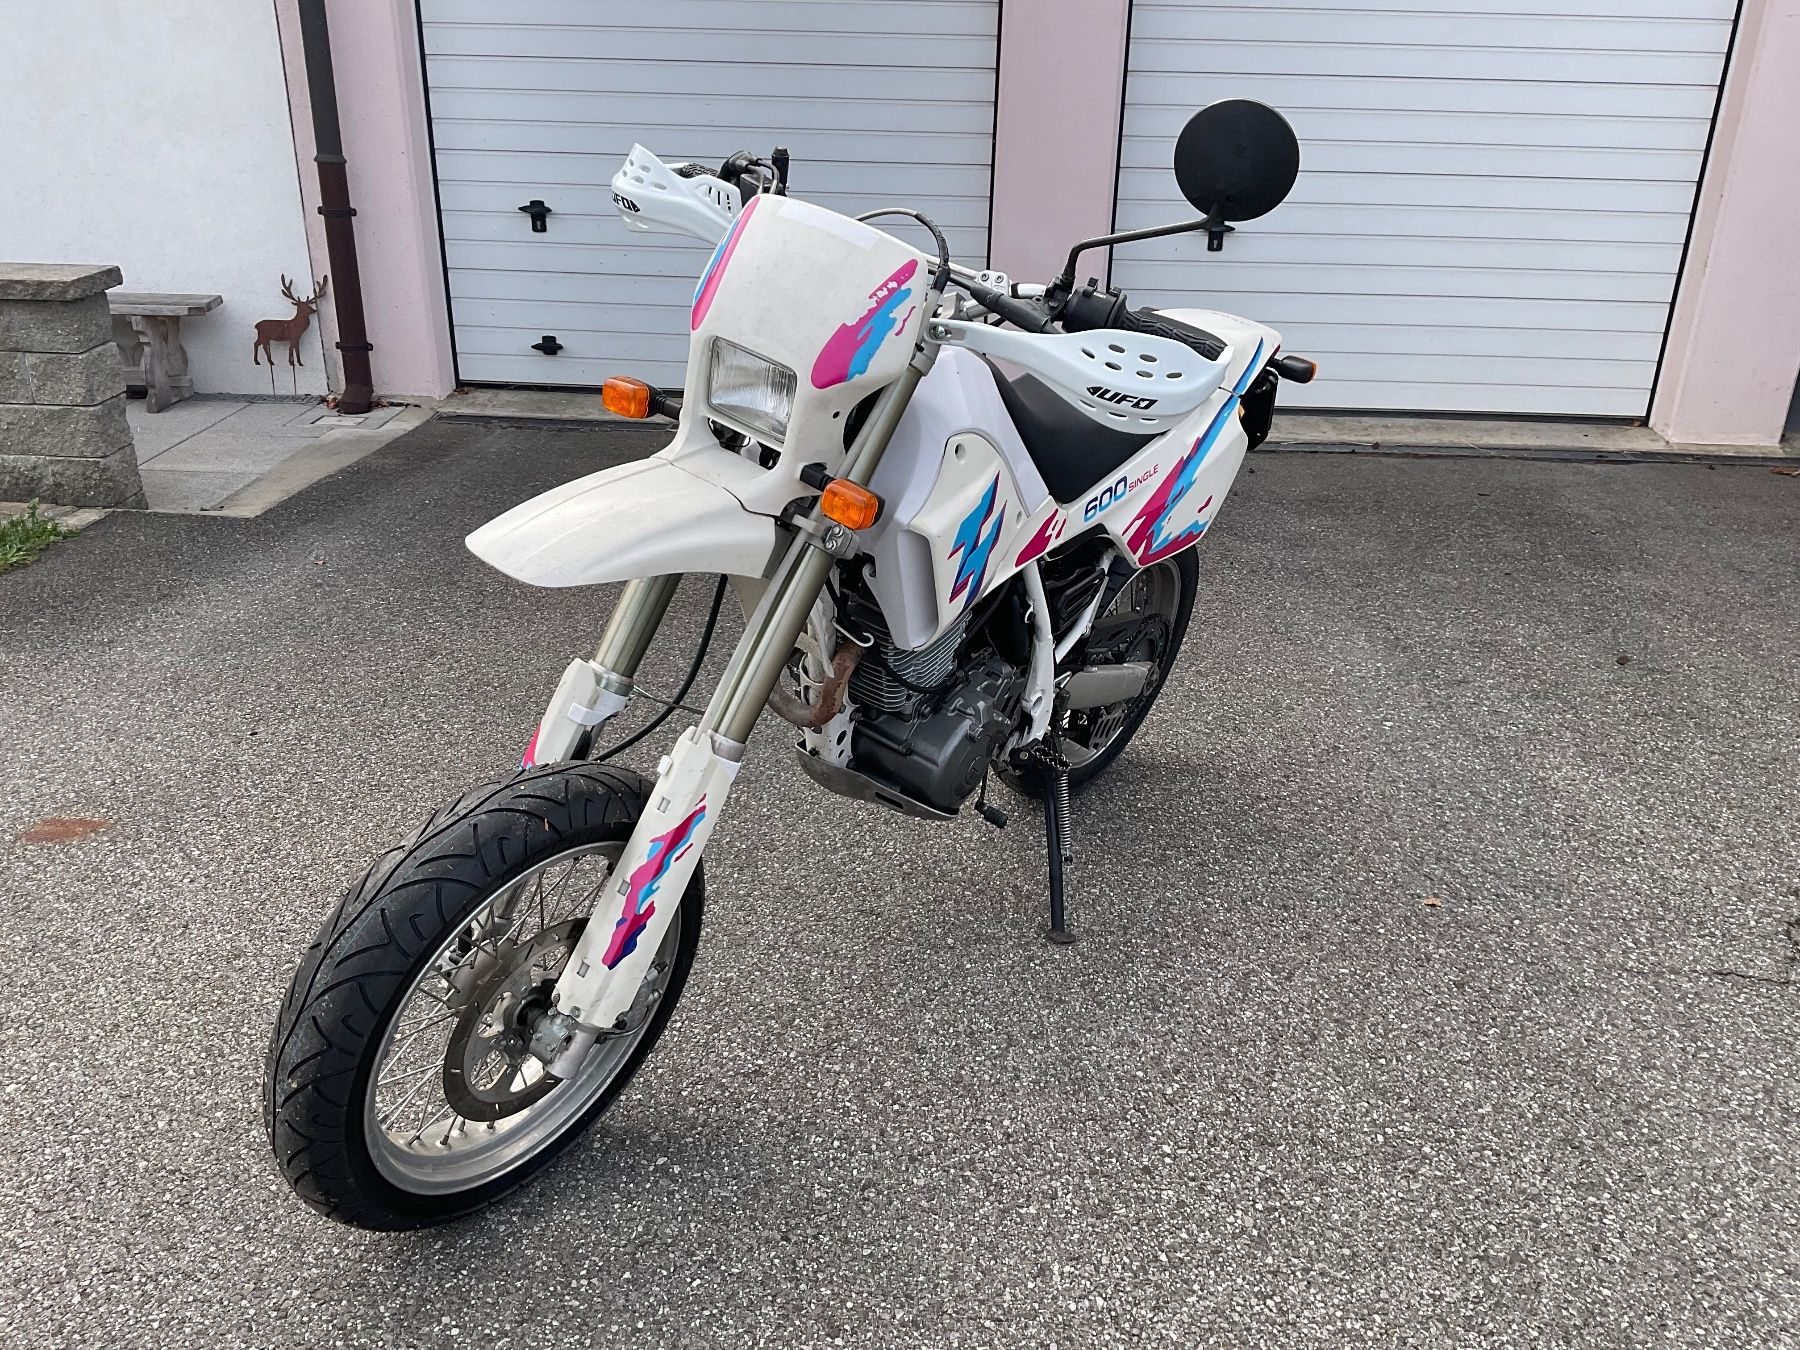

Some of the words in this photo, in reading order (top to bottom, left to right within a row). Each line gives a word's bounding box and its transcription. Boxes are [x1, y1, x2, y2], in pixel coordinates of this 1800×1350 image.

[1096, 388, 1158, 410] UFO
[1083, 475, 1128, 523] 600
[1128, 464, 1159, 492] SINGLE
